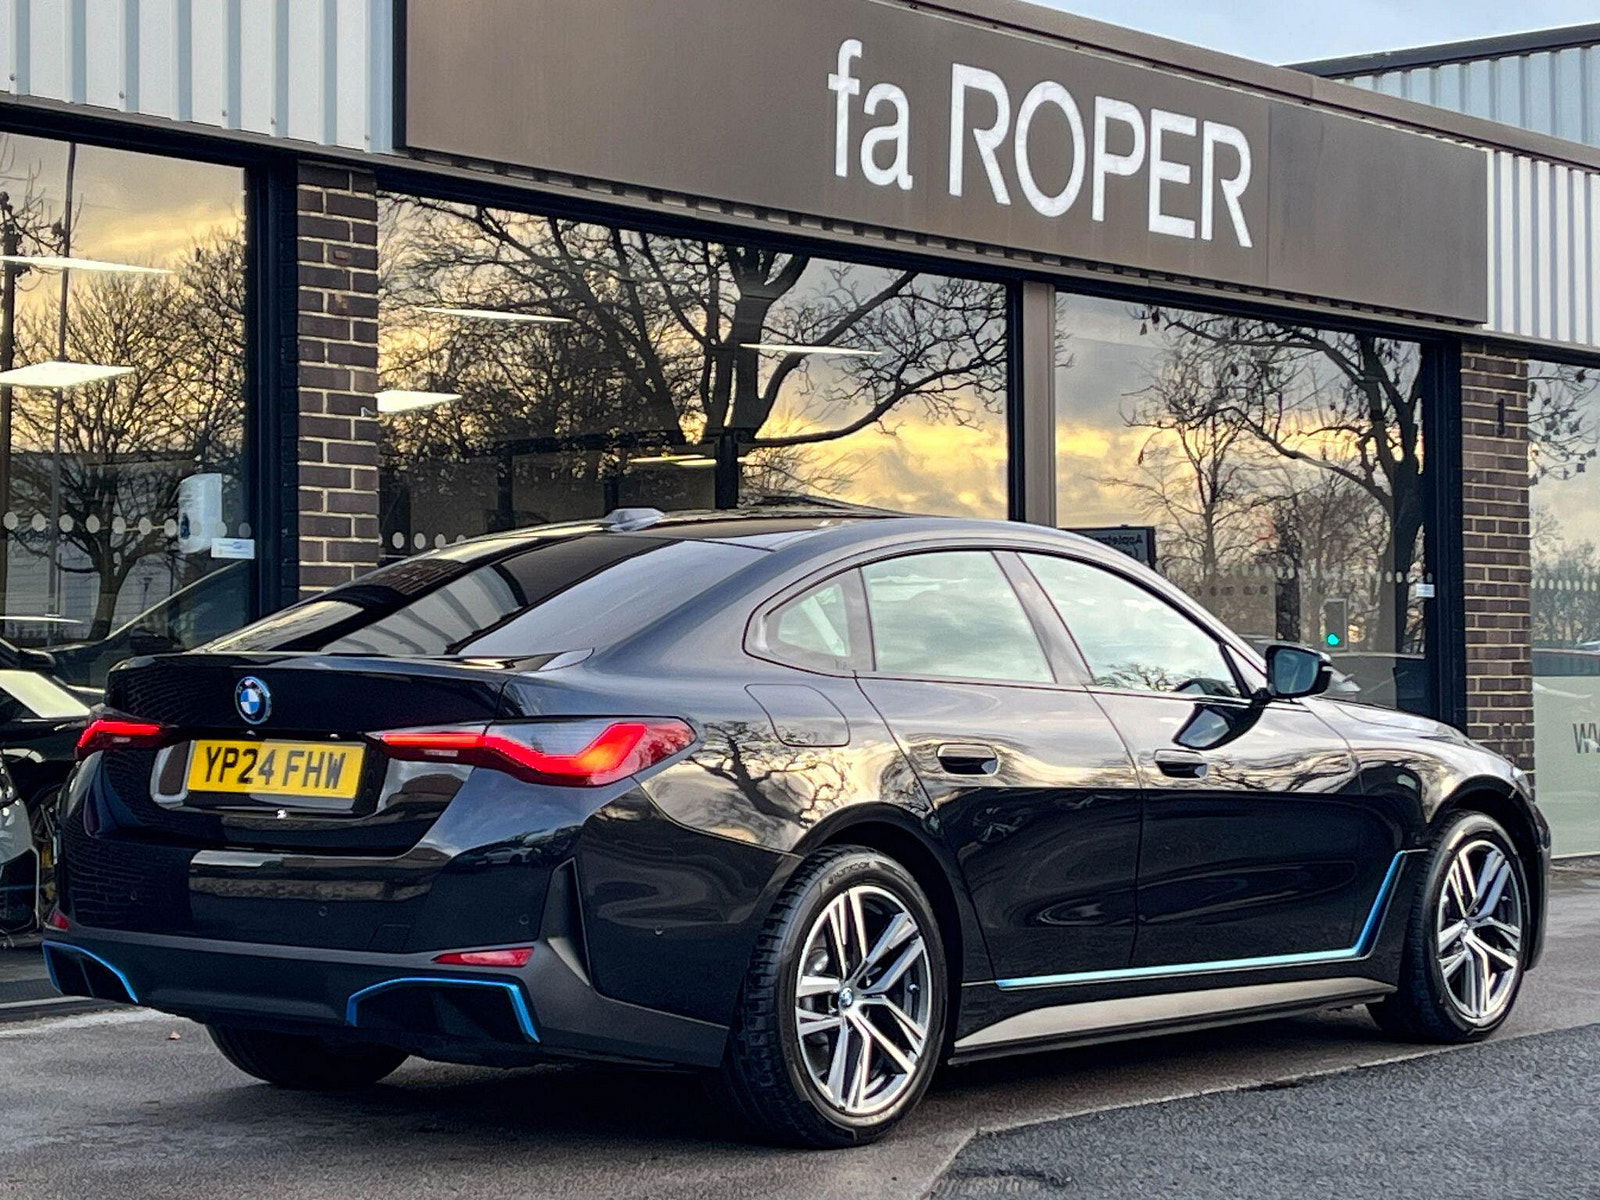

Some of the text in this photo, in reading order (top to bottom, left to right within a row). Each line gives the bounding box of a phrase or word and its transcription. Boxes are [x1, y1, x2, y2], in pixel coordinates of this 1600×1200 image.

[827, 38, 1253, 248] fa ROPER
[205, 746, 347, 790] YP24 FHW
